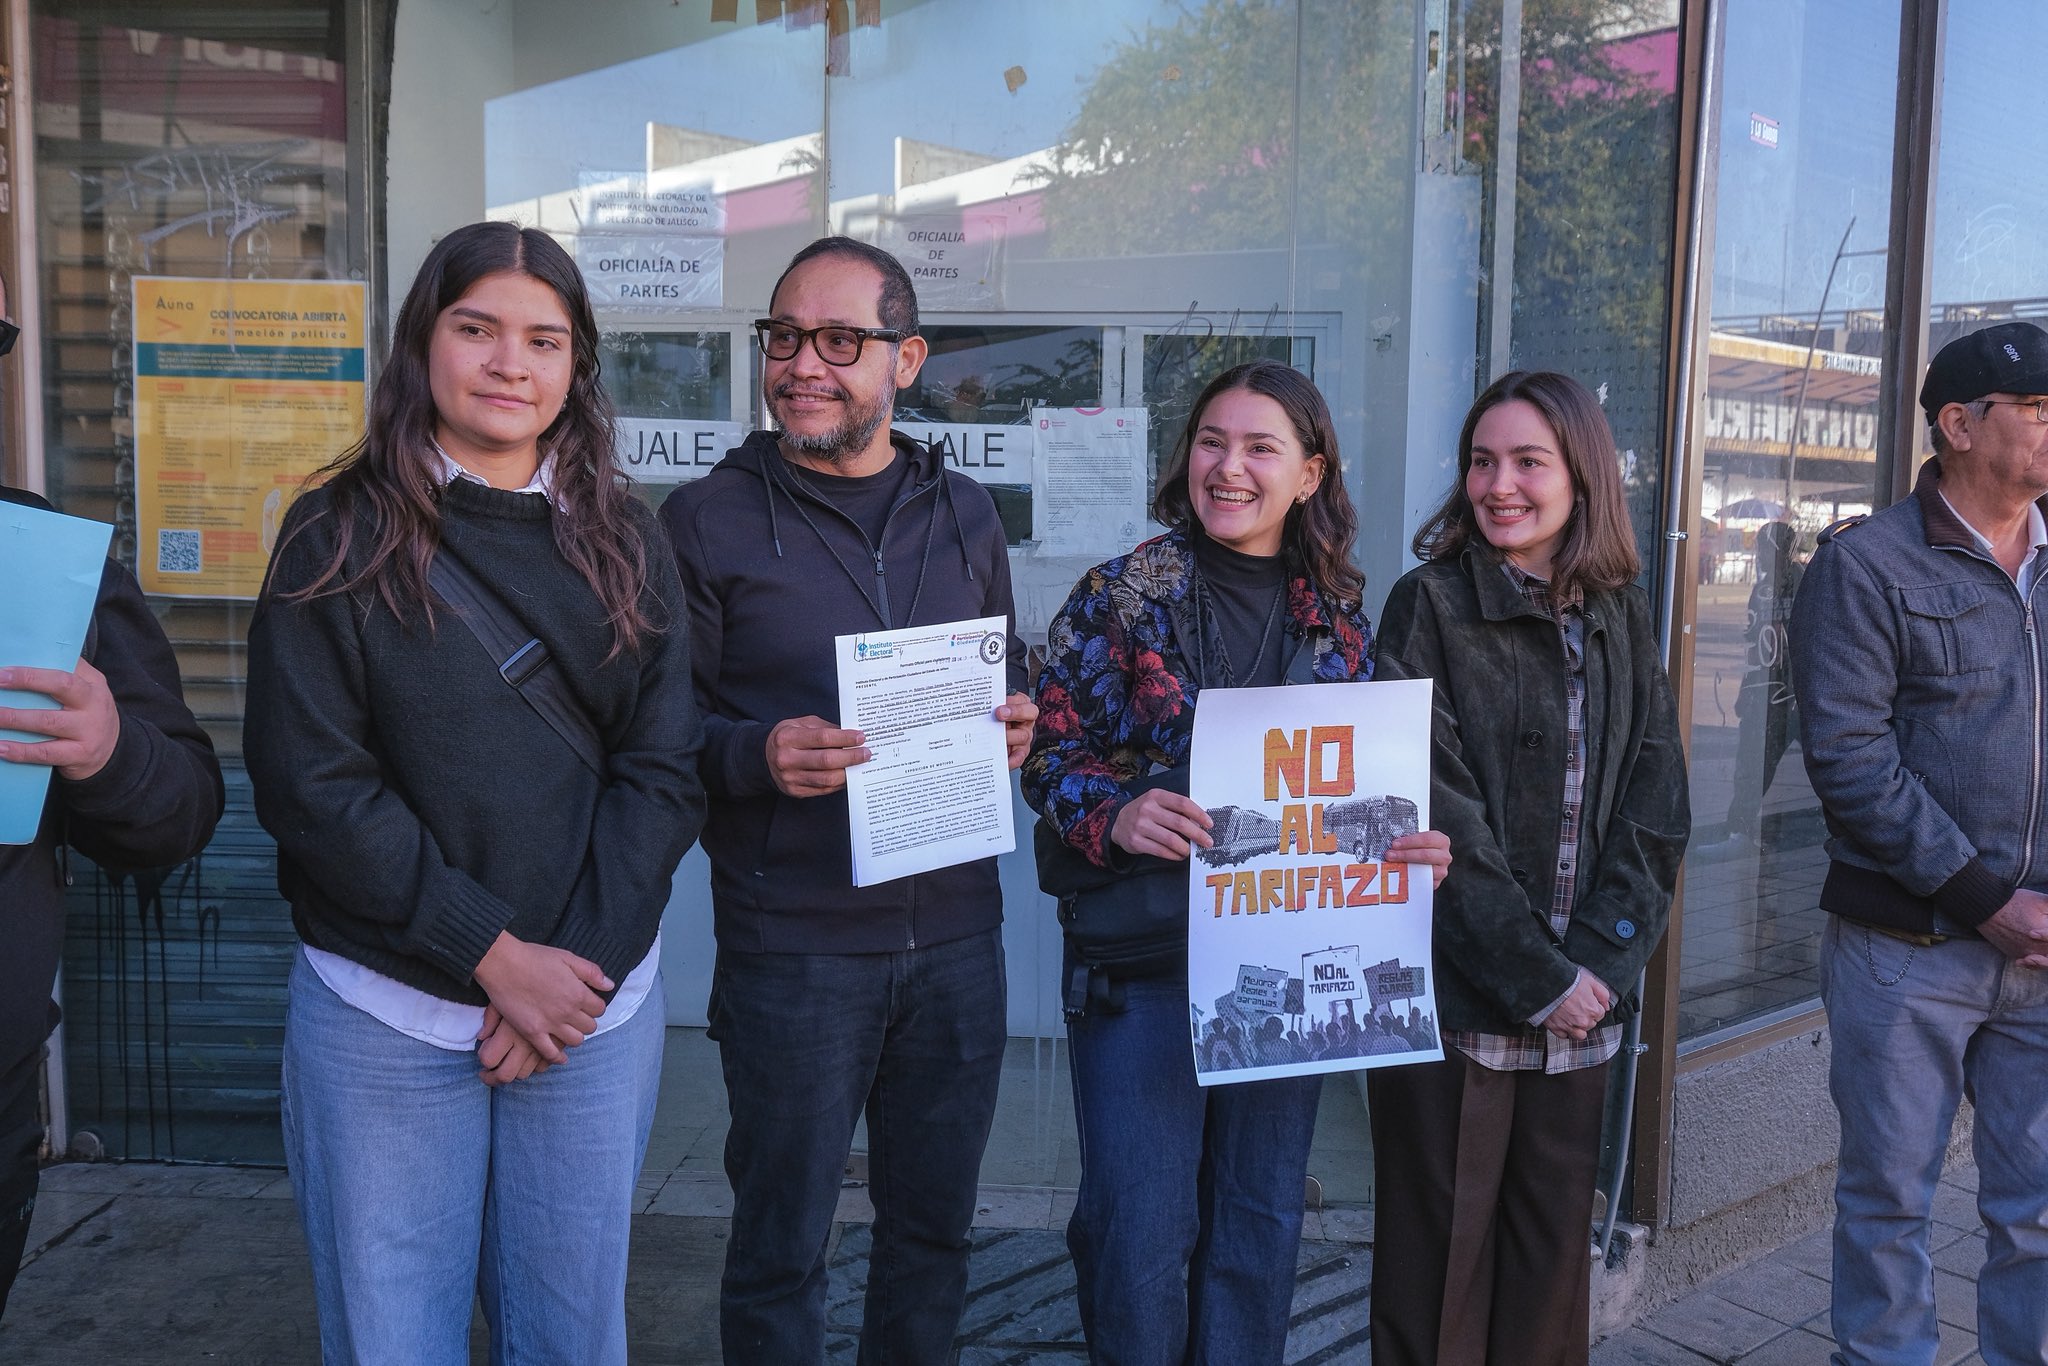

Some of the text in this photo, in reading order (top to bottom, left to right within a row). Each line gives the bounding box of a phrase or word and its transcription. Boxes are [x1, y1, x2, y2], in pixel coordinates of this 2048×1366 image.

[696, 194, 706, 202] DE
[659, 205, 708, 215] CIUDADANA
[621, 216, 653, 225] ESTADO
[655, 217, 666, 226] DE
[667, 217, 698, 226] JALISCO
[908, 231, 966, 243] OFICIALIA
[928, 249, 945, 260] DE
[599, 256, 700, 273] OFICIALÍA DE
[913, 267, 959, 278] PARTES
[620, 284, 679, 298] PARTES
[156, 295, 194, 311] Auna
[303, 311, 346, 322] ABIERTA
[212, 327, 284, 338] Fomación
[2003, 344, 2021, 362] HUGO
[628, 431, 715, 466] JALE
[868, 641, 893, 650] Instituto
[869, 647, 893, 658] Electoral
[1264, 725, 1355, 802] NO
[1279, 804, 1338, 855] AL
[1206, 862, 1409, 918] TARIFAZO
[1313, 963, 1350, 981] NO AL
[1243, 975, 1277, 988] Mejoras
[1308, 981, 1355, 994] TARIFAZO
